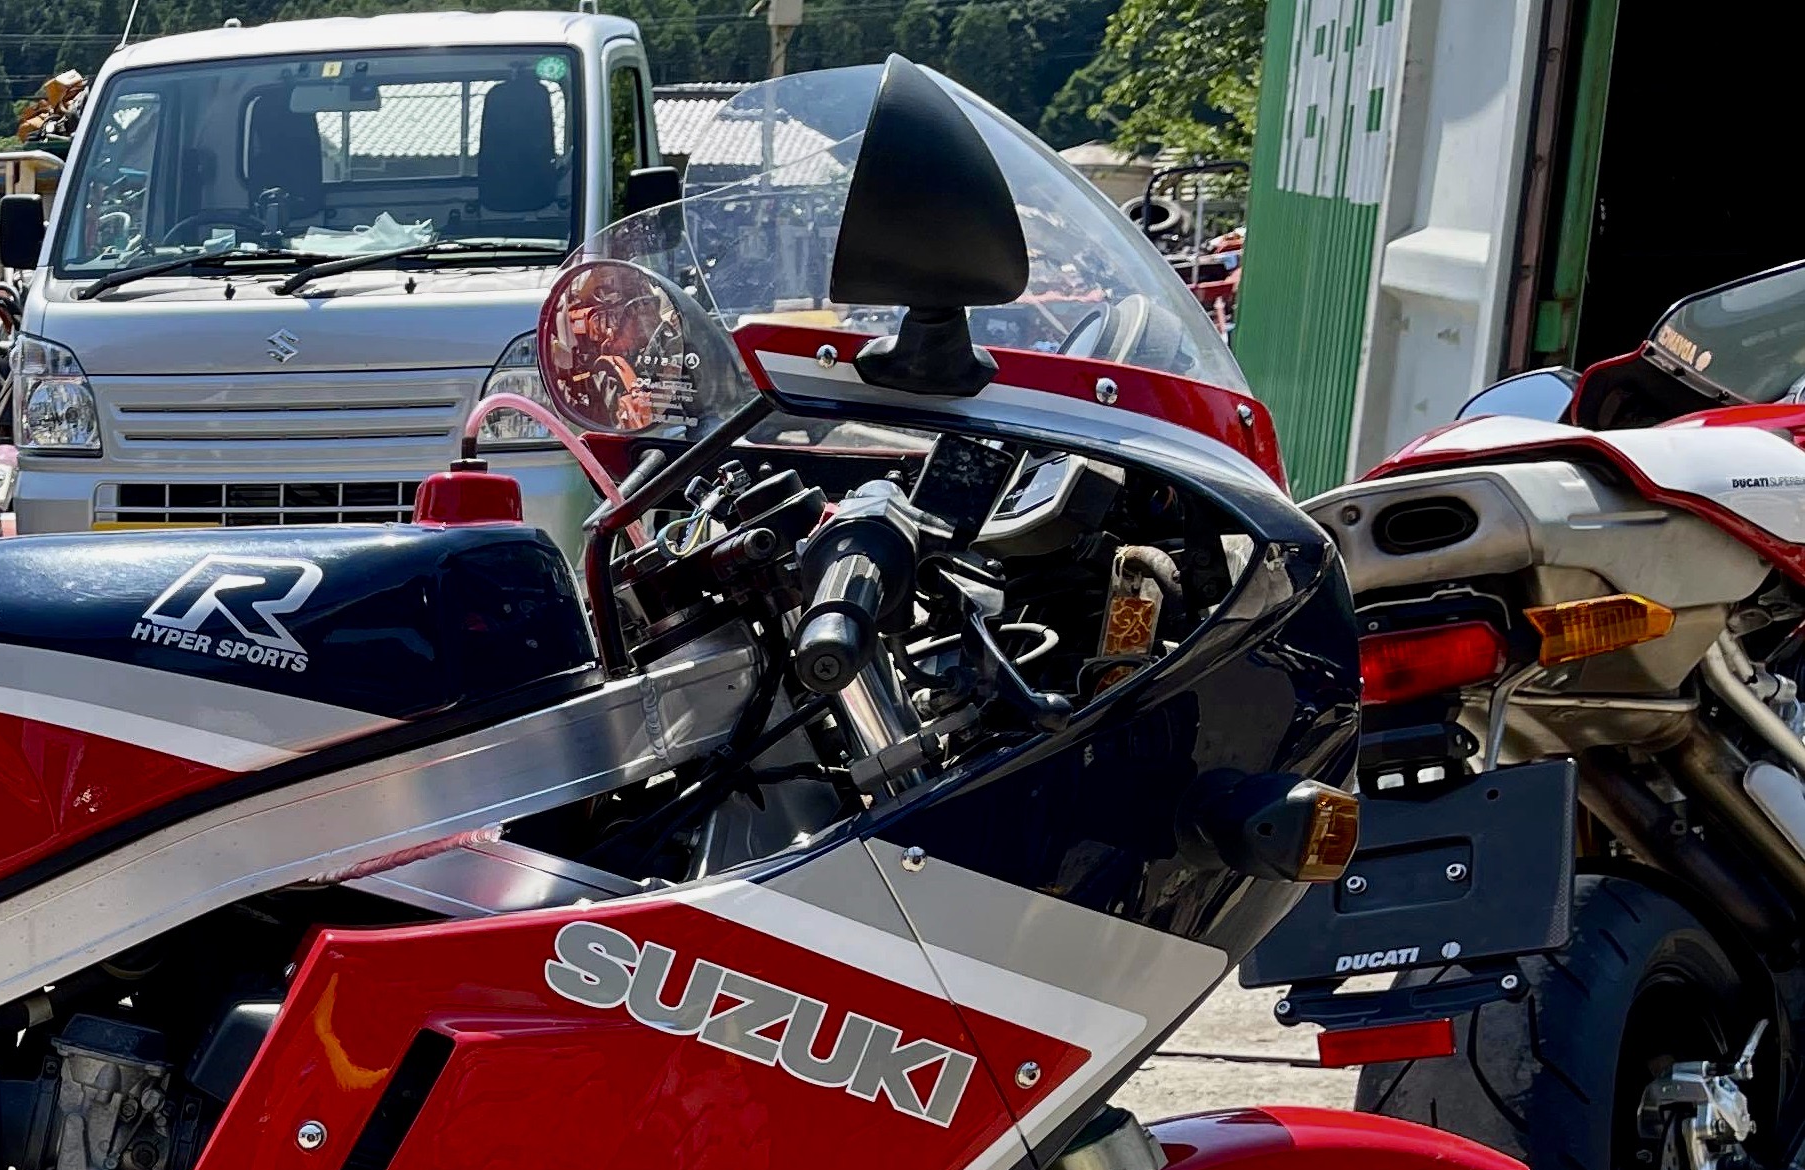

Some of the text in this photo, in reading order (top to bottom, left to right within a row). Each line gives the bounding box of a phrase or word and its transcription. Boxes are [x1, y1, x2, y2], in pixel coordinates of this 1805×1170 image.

[1732, 477, 1769, 488] DUCATI
[141, 553, 323, 655] R
[131, 622, 309, 672] HYPER SPORTS
[1335, 947, 1420, 972] DUCATI
[544, 920, 978, 1128] SUZUKI
